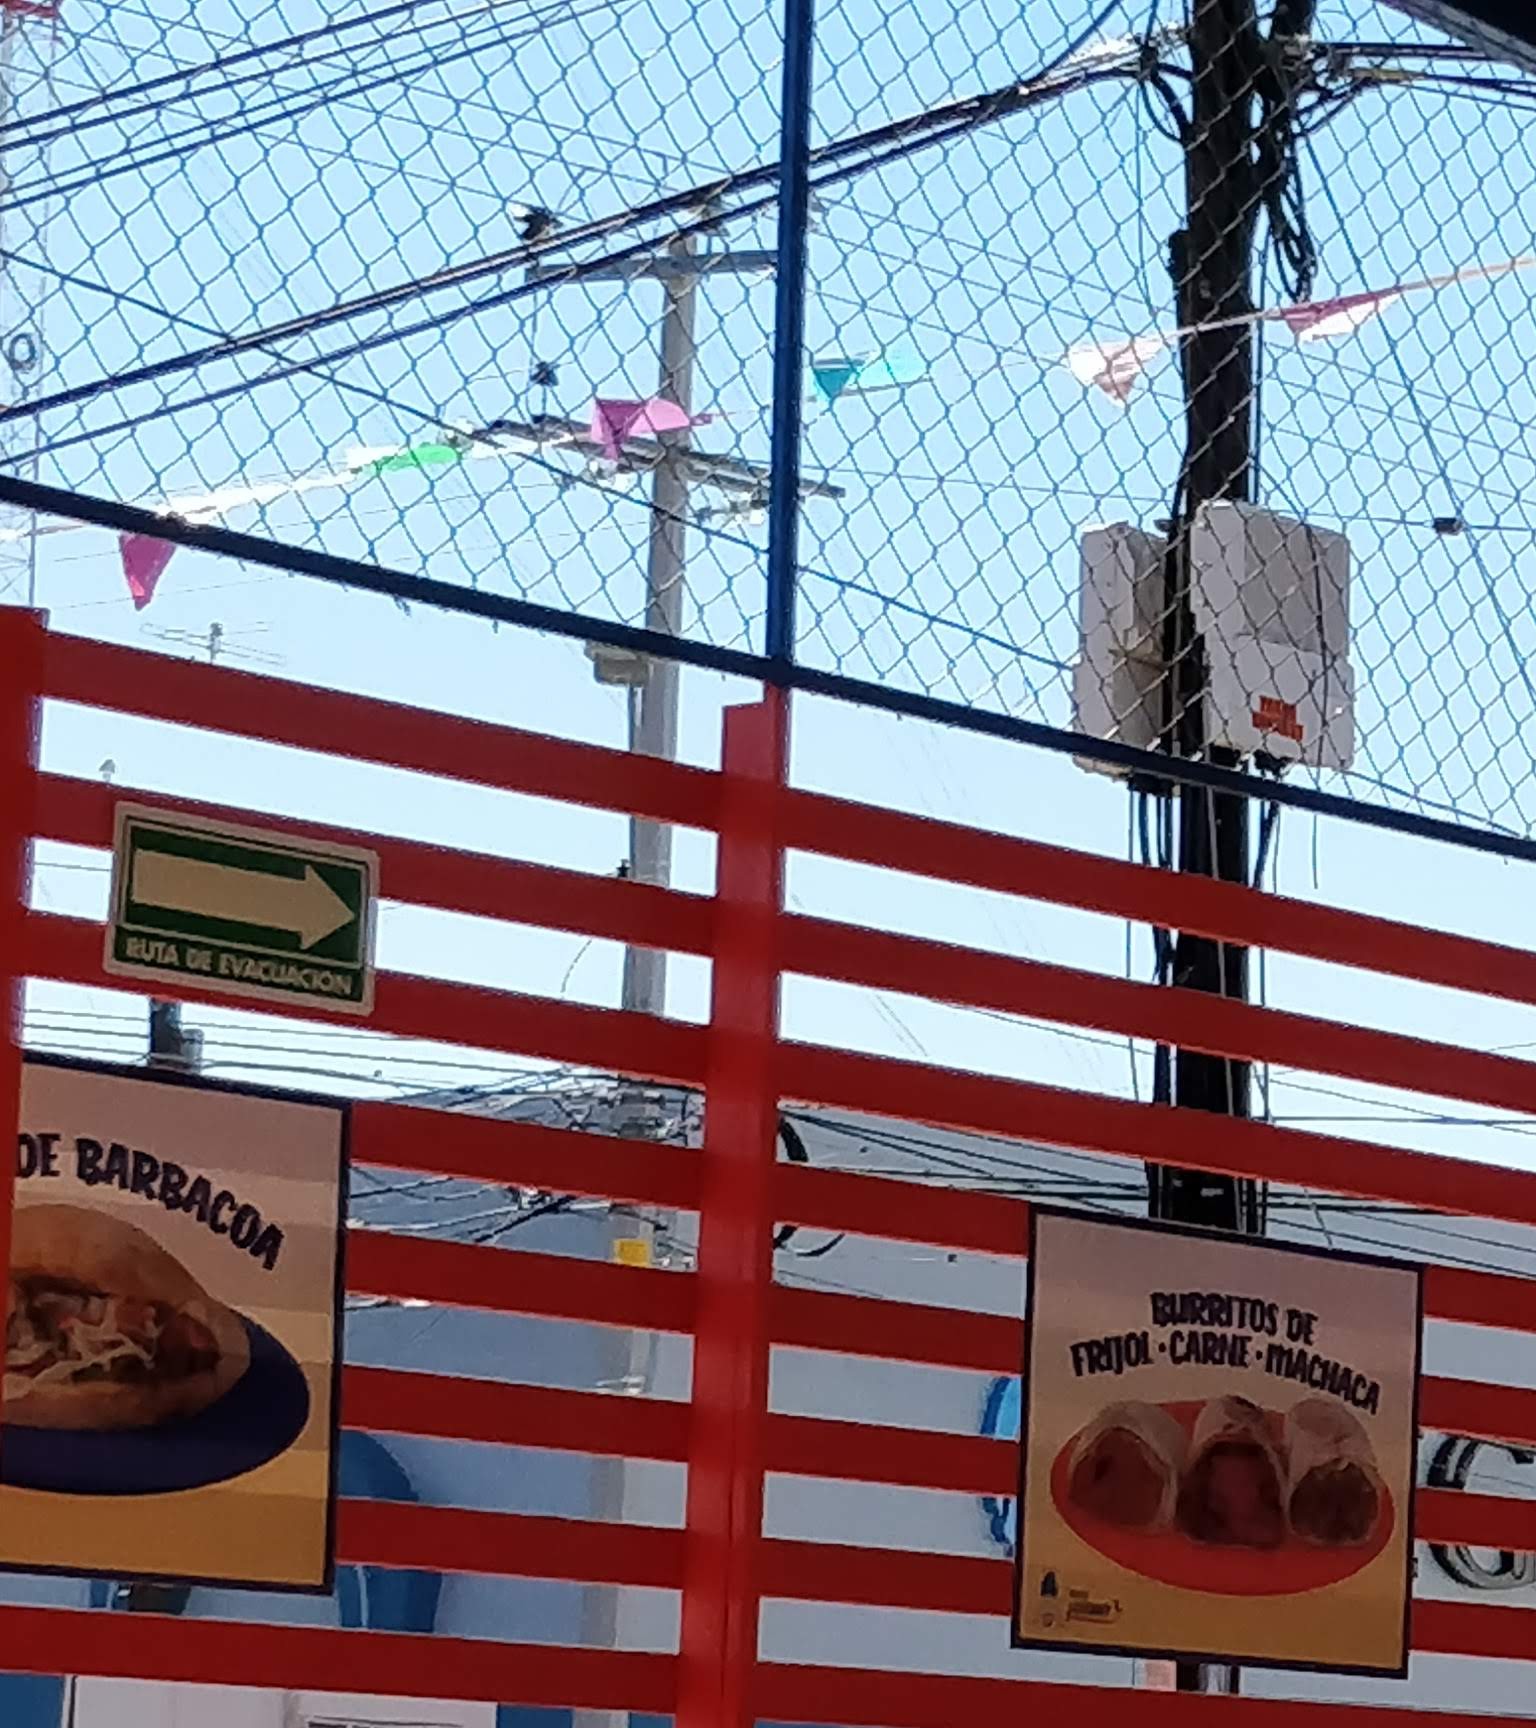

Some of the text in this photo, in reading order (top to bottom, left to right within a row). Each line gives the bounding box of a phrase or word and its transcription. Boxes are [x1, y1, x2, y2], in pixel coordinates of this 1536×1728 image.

[126, 938, 178, 964] RUTA
[186, 948, 212, 971] DE
[76, 1138, 286, 1271] BARBACOA
[1150, 1292, 1318, 1346] BURRITOS DE
[1070, 1330, 1381, 1416] FRIJOL CARNE MACHACA
